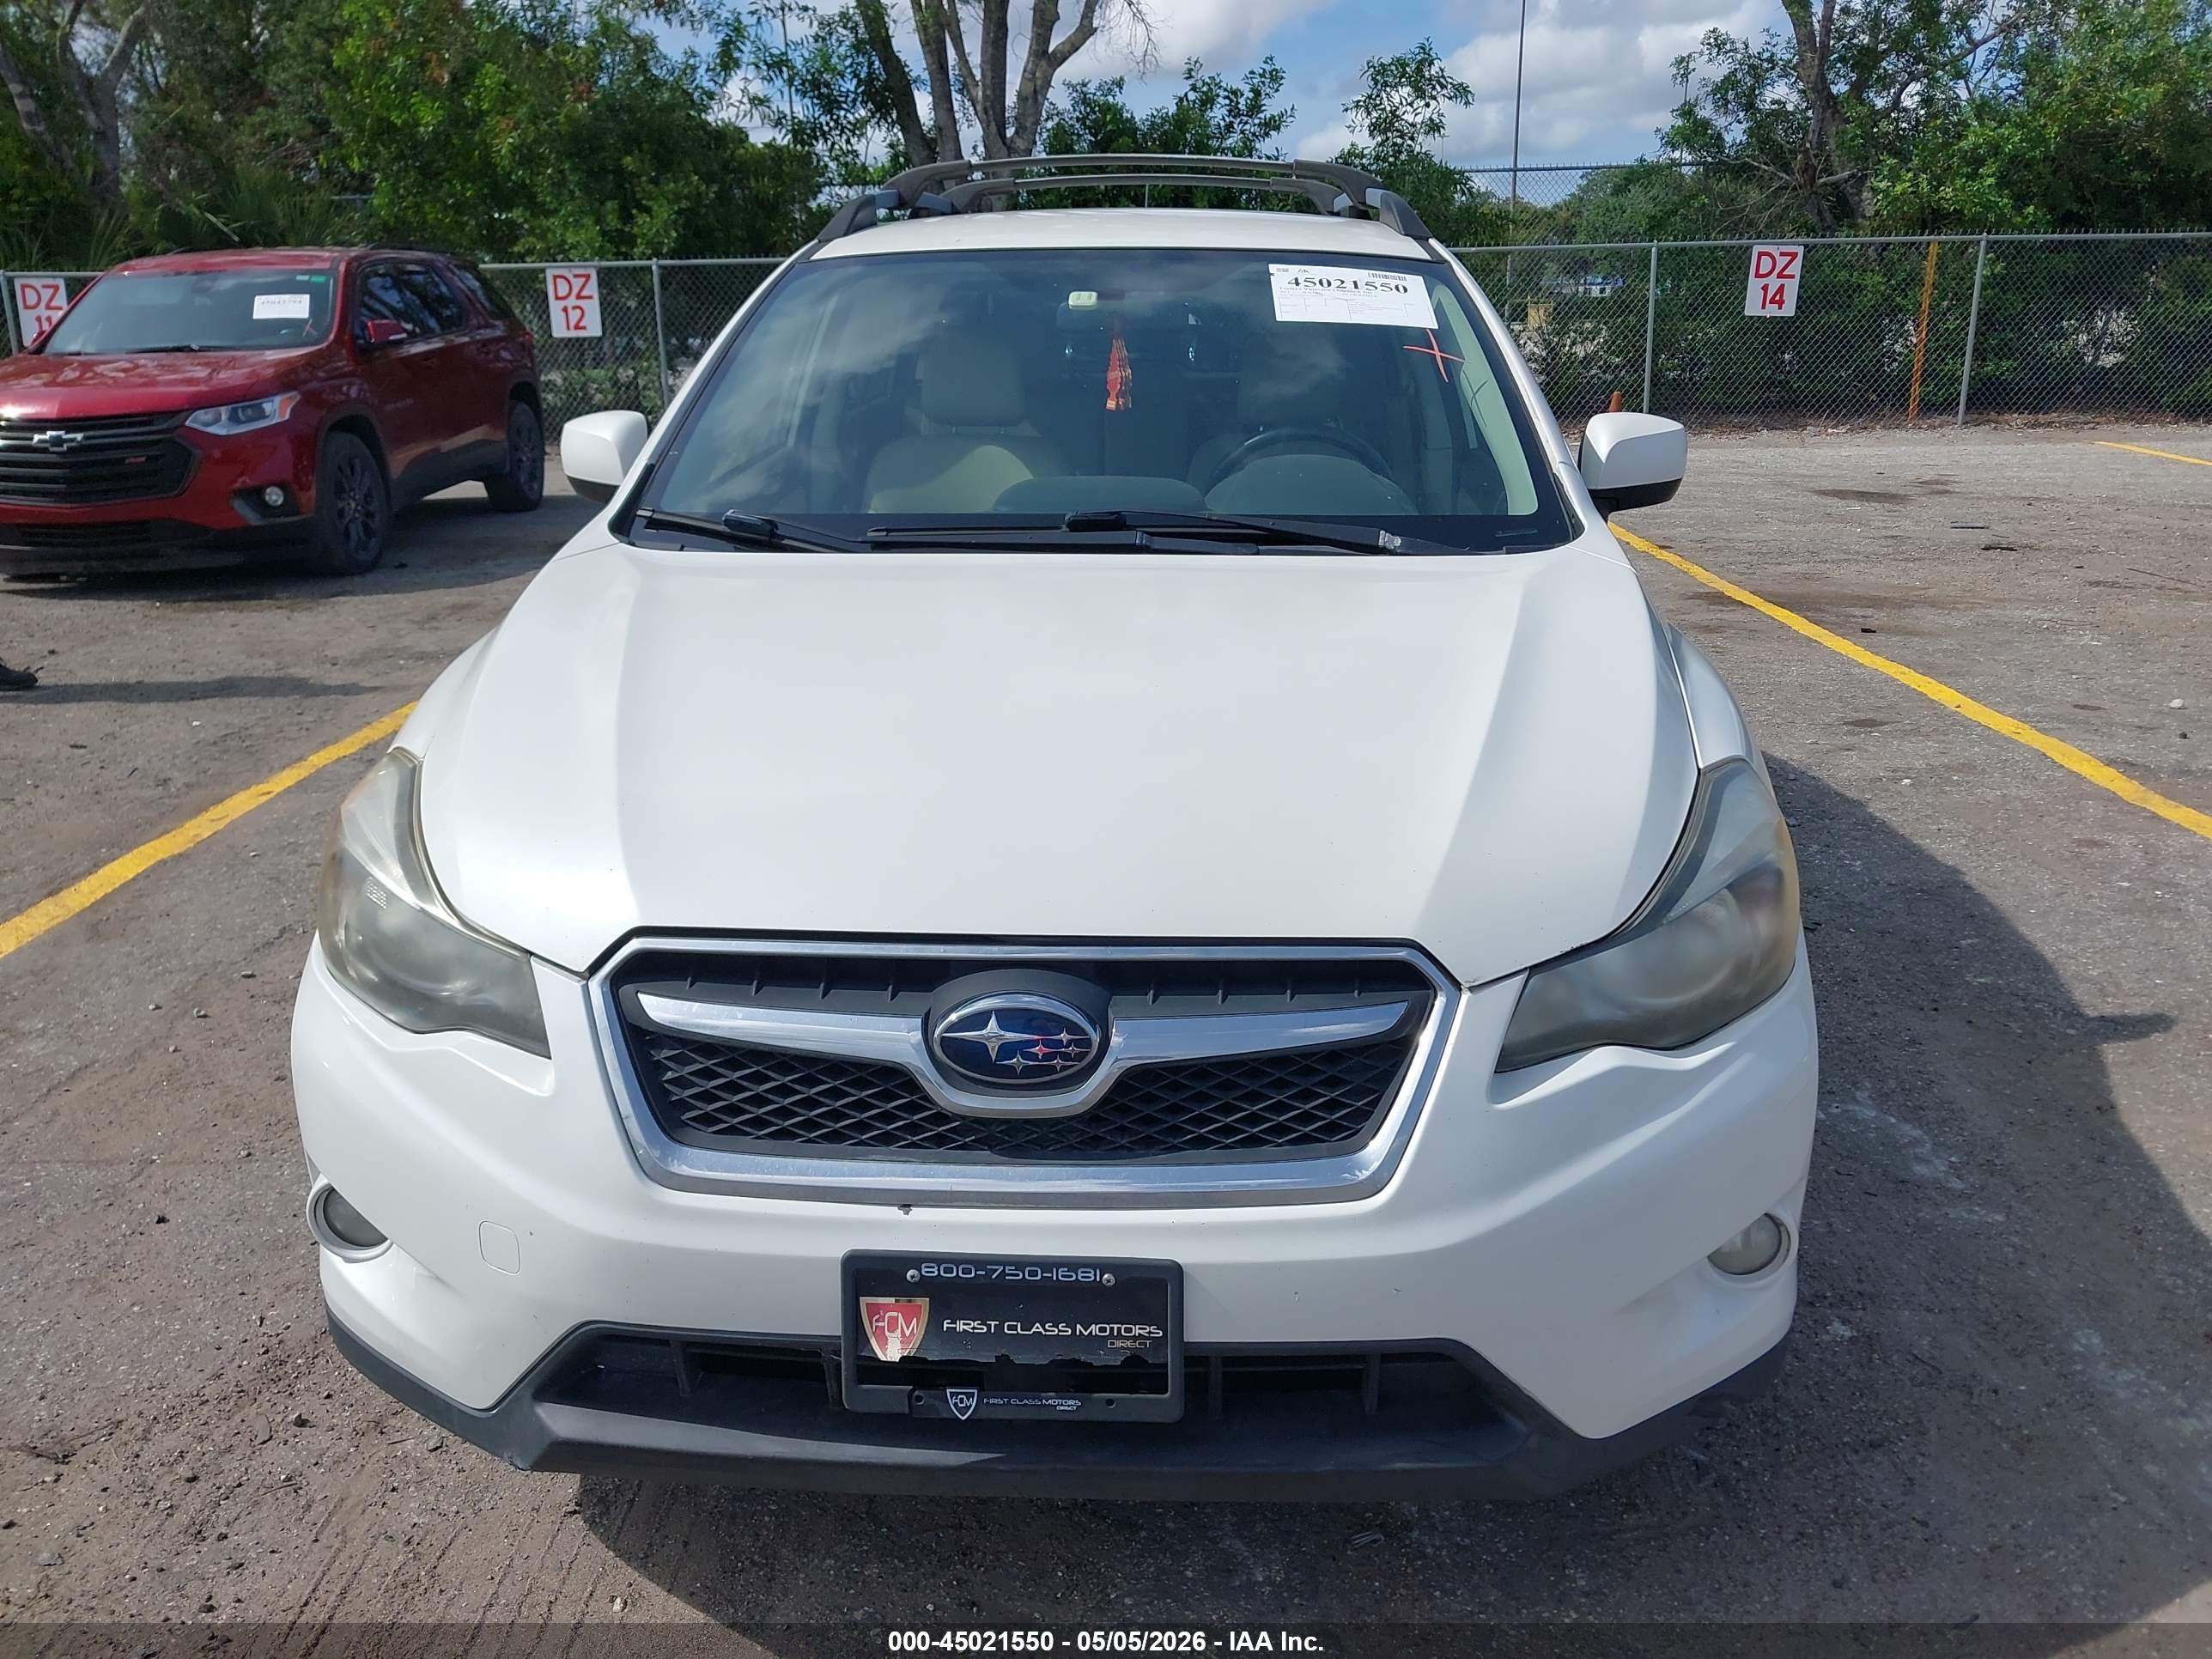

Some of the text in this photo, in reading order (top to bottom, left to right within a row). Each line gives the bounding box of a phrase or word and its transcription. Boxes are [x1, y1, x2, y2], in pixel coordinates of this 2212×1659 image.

[1754, 251, 1799, 279] DZ
[20, 283, 64, 311] DZ
[552, 273, 593, 301] DZ
[1288, 276, 1408, 295] 45021550
[1760, 283, 1786, 310] 14
[562, 305, 587, 331] 12
[921, 1262, 1101, 1282] 800-750-1681
[943, 1319, 1164, 1338] FIRST CLASS MOTORS
[1107, 1340, 1153, 1348] DIRECT
